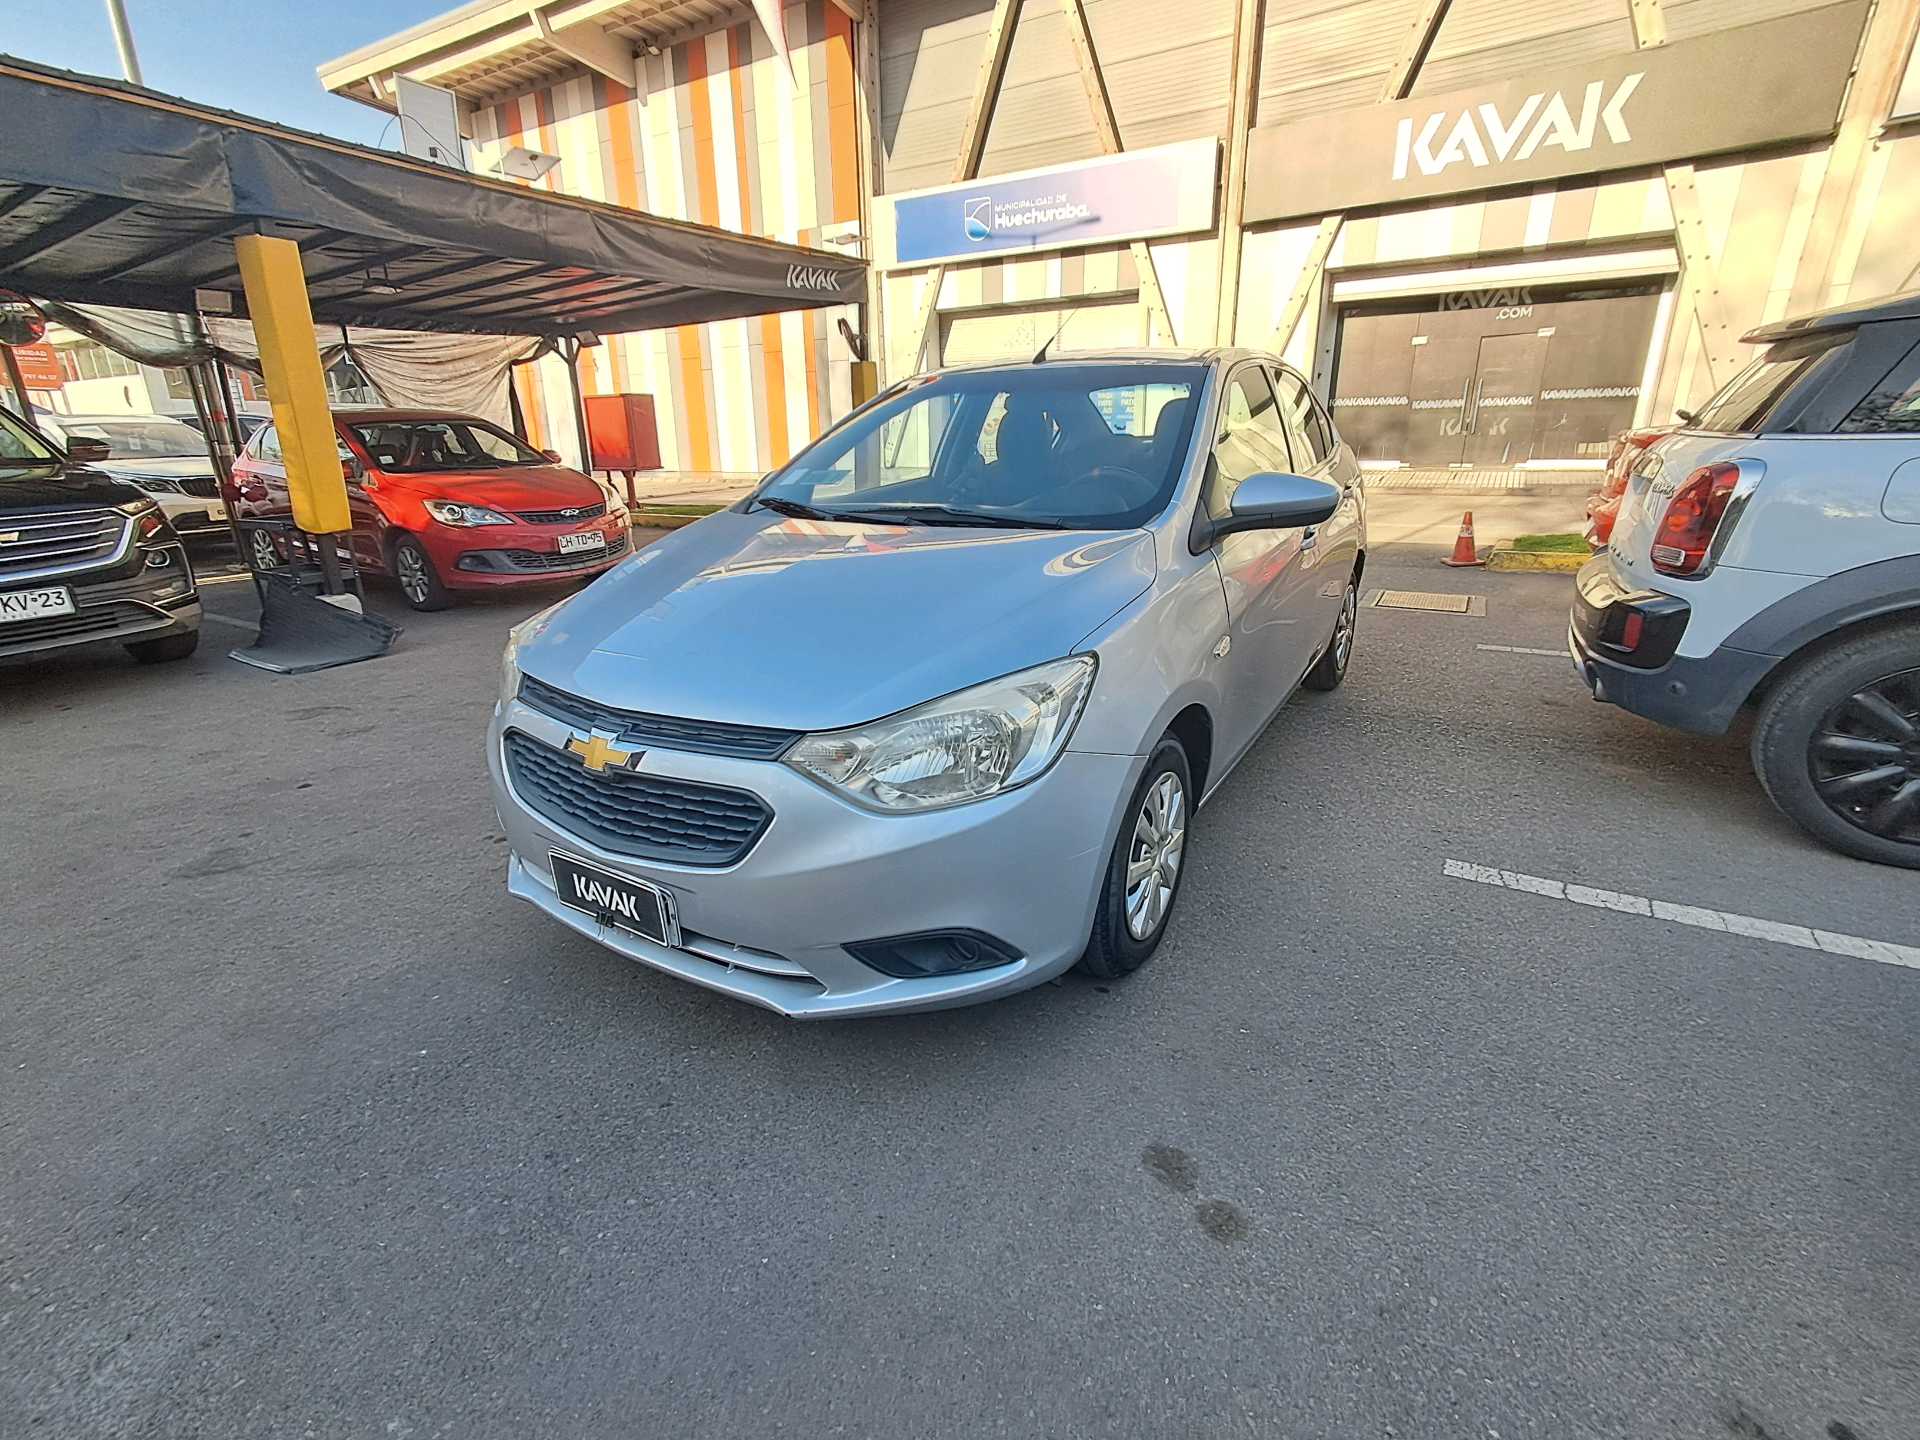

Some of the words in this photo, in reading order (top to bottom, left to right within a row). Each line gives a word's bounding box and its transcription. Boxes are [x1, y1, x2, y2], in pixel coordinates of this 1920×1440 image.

[1392, 72, 1646, 181] KAVAK
[786, 263, 841, 292] KAVAK
[1438, 287, 1533, 313] KAVAK
[572, 872, 641, 922] KAVAK
